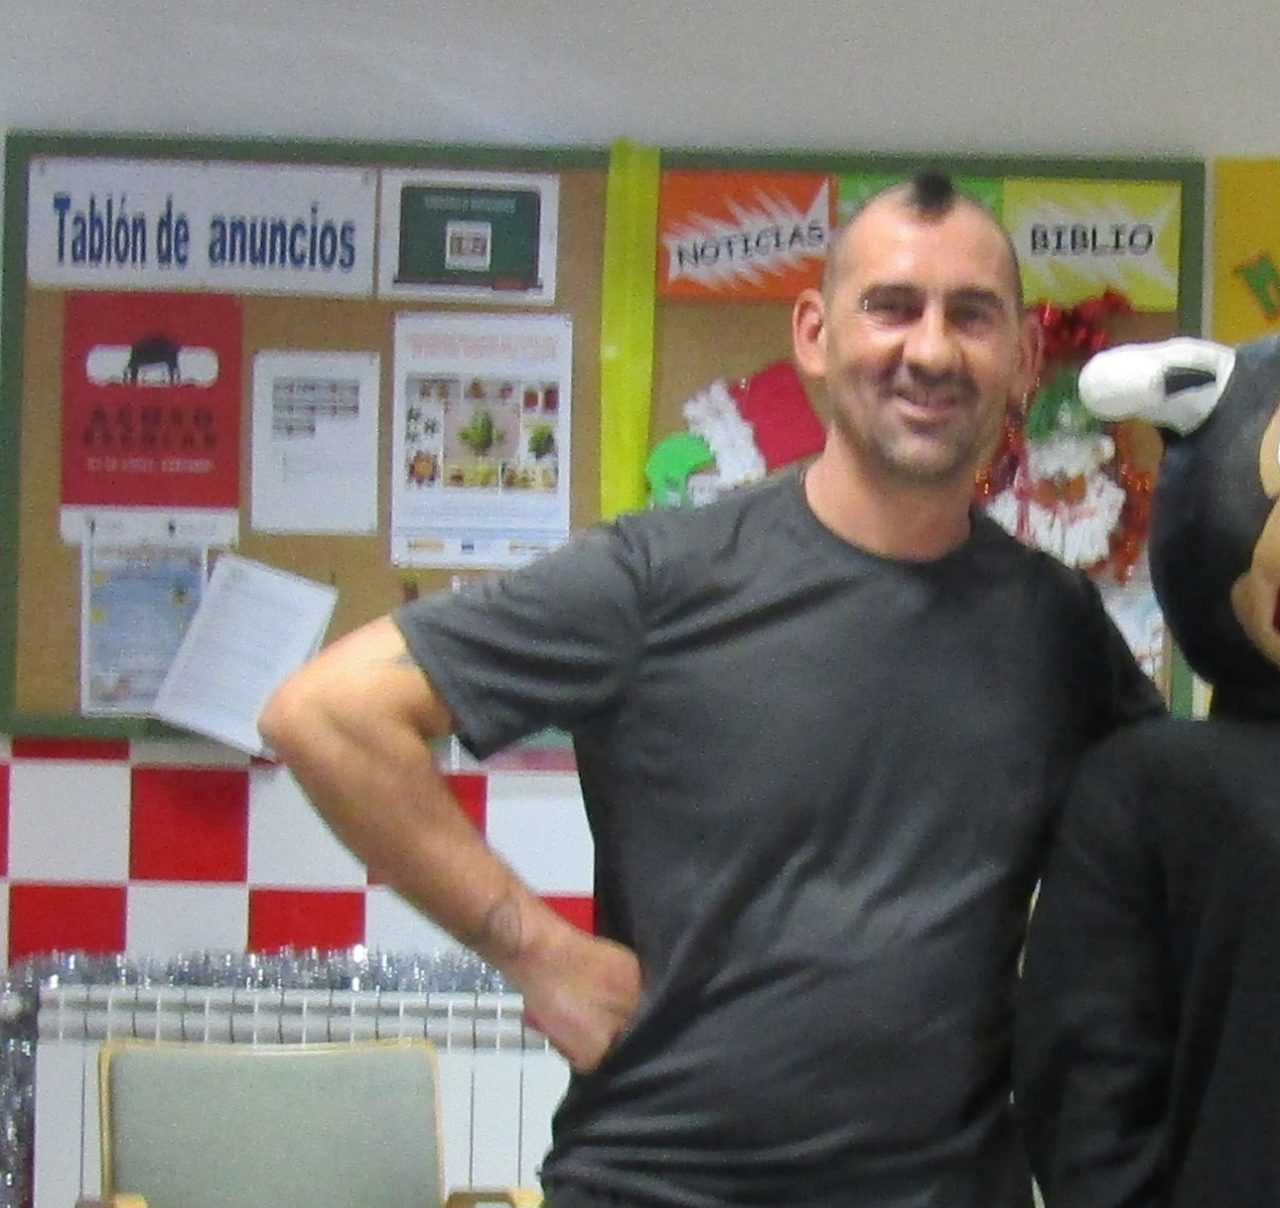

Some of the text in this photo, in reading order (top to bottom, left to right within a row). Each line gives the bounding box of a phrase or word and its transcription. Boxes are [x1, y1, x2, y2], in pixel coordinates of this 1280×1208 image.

[53, 191, 357, 272] Tablón de anuncios
[677, 219, 825, 269] NOTICIAS
[1031, 223, 1154, 256] BIBLIO
